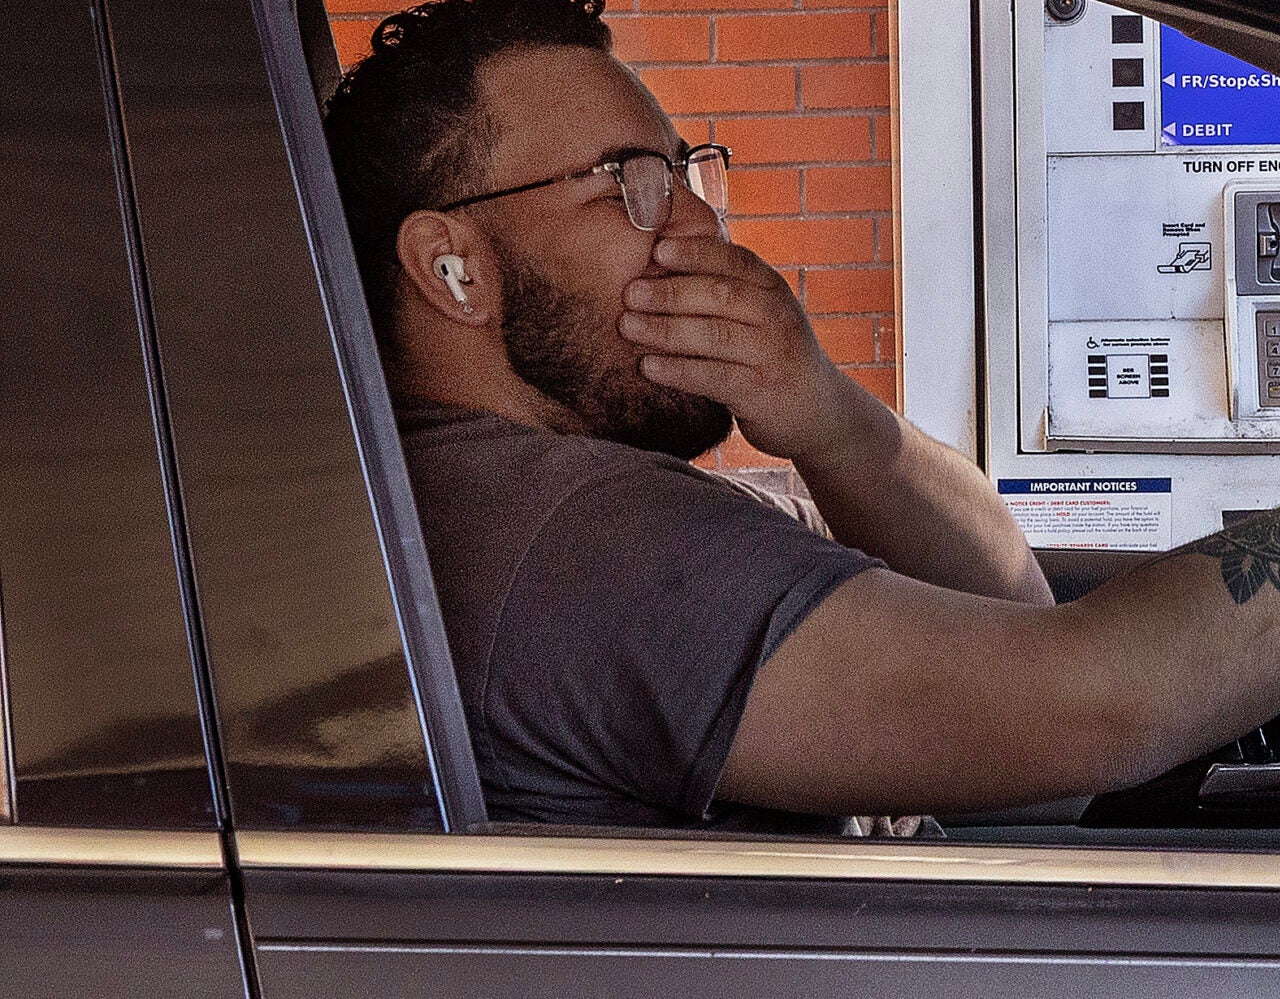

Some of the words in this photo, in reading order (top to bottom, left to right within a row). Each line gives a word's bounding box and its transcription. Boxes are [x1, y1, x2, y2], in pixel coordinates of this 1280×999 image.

[1182, 123, 1233, 137] DEBIT
[1183, 161, 1222, 173] TURN
[1226, 160, 1255, 172] OFF
[1030, 482, 1090, 492] IMPORTANT
[1094, 481, 1137, 491] NOTICES
